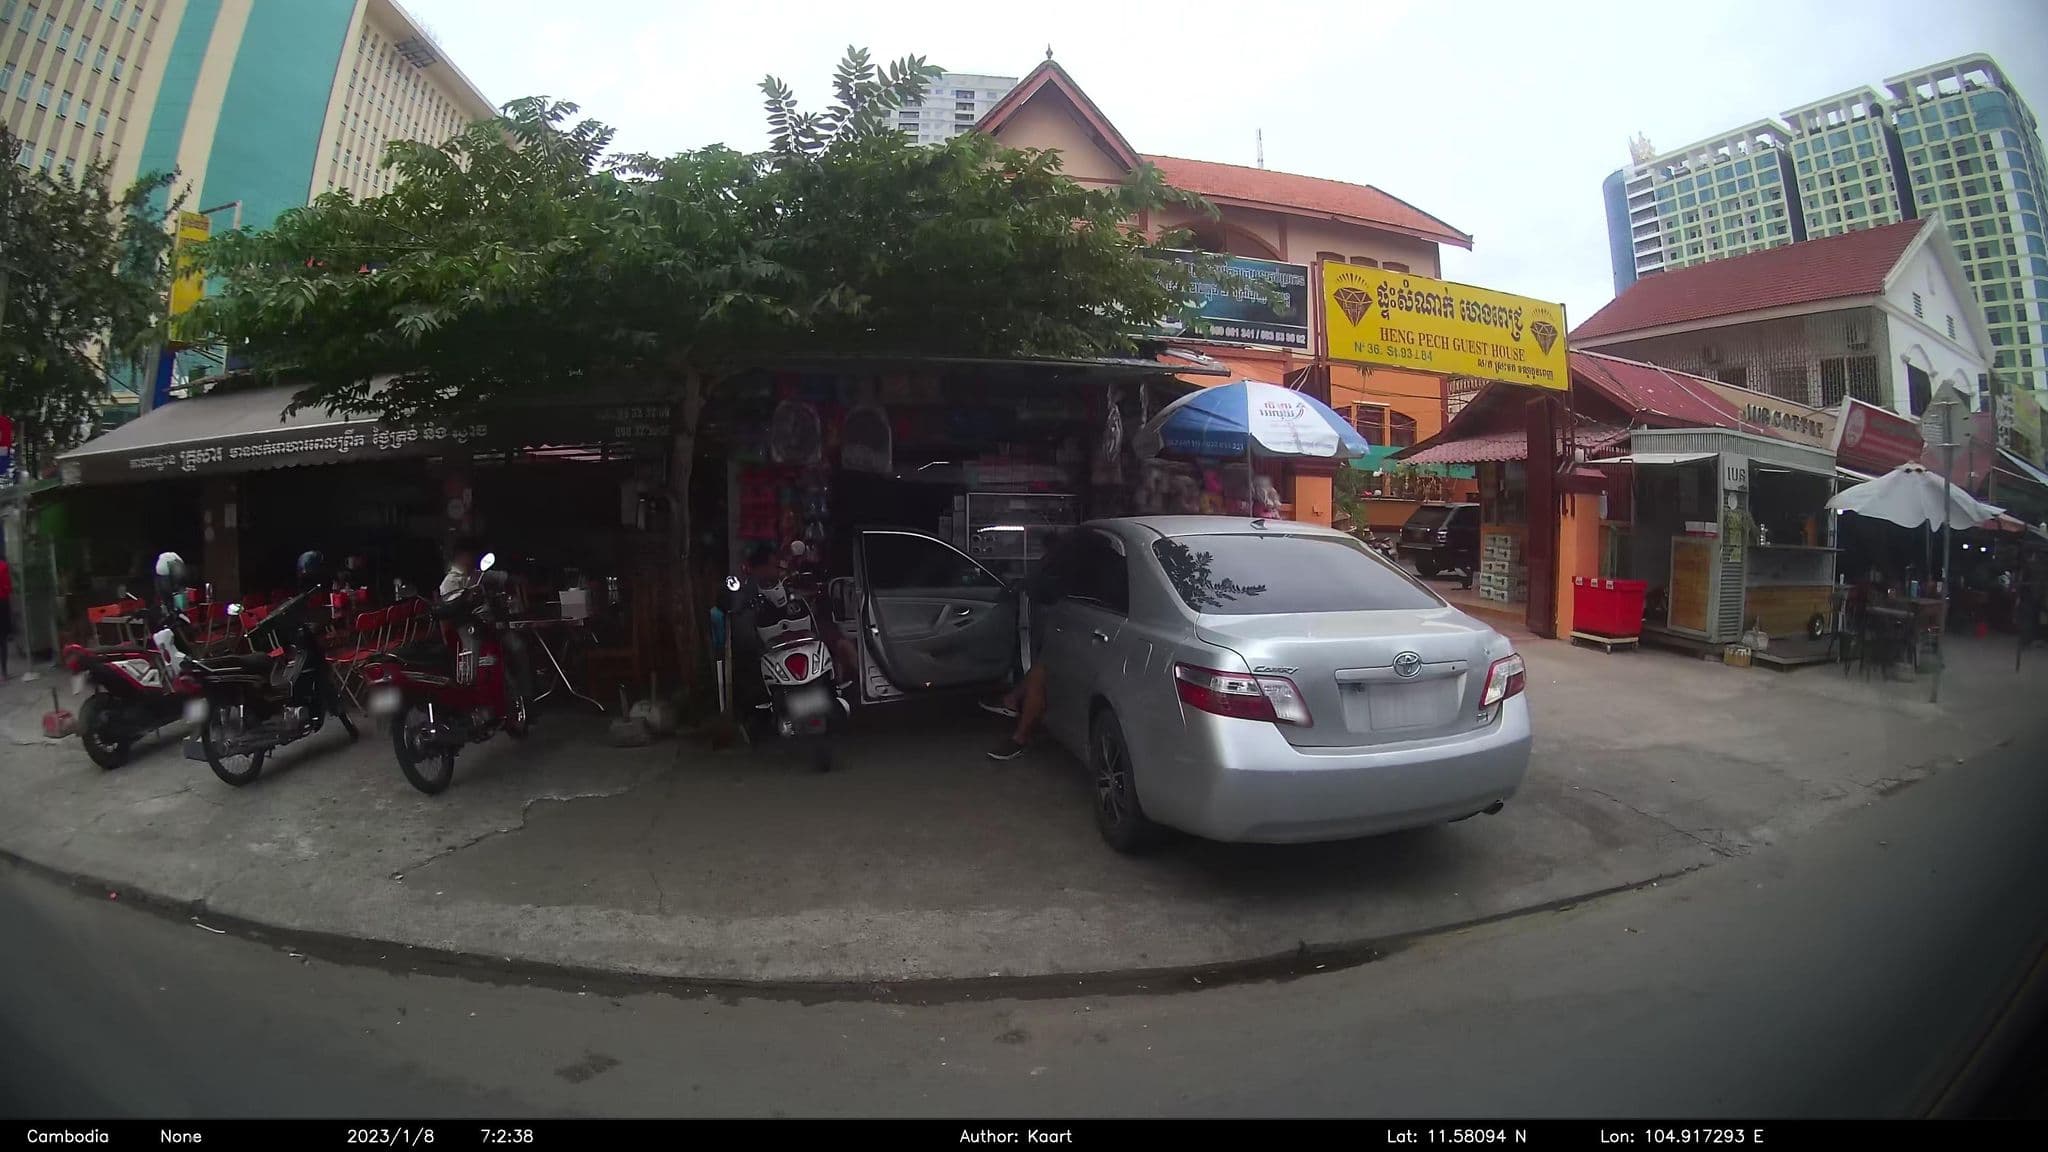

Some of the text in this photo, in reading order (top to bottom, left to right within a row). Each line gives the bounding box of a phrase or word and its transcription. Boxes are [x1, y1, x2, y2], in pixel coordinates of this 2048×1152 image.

[1380, 327, 1525, 361] HENG PECH GUEST HOUSE
